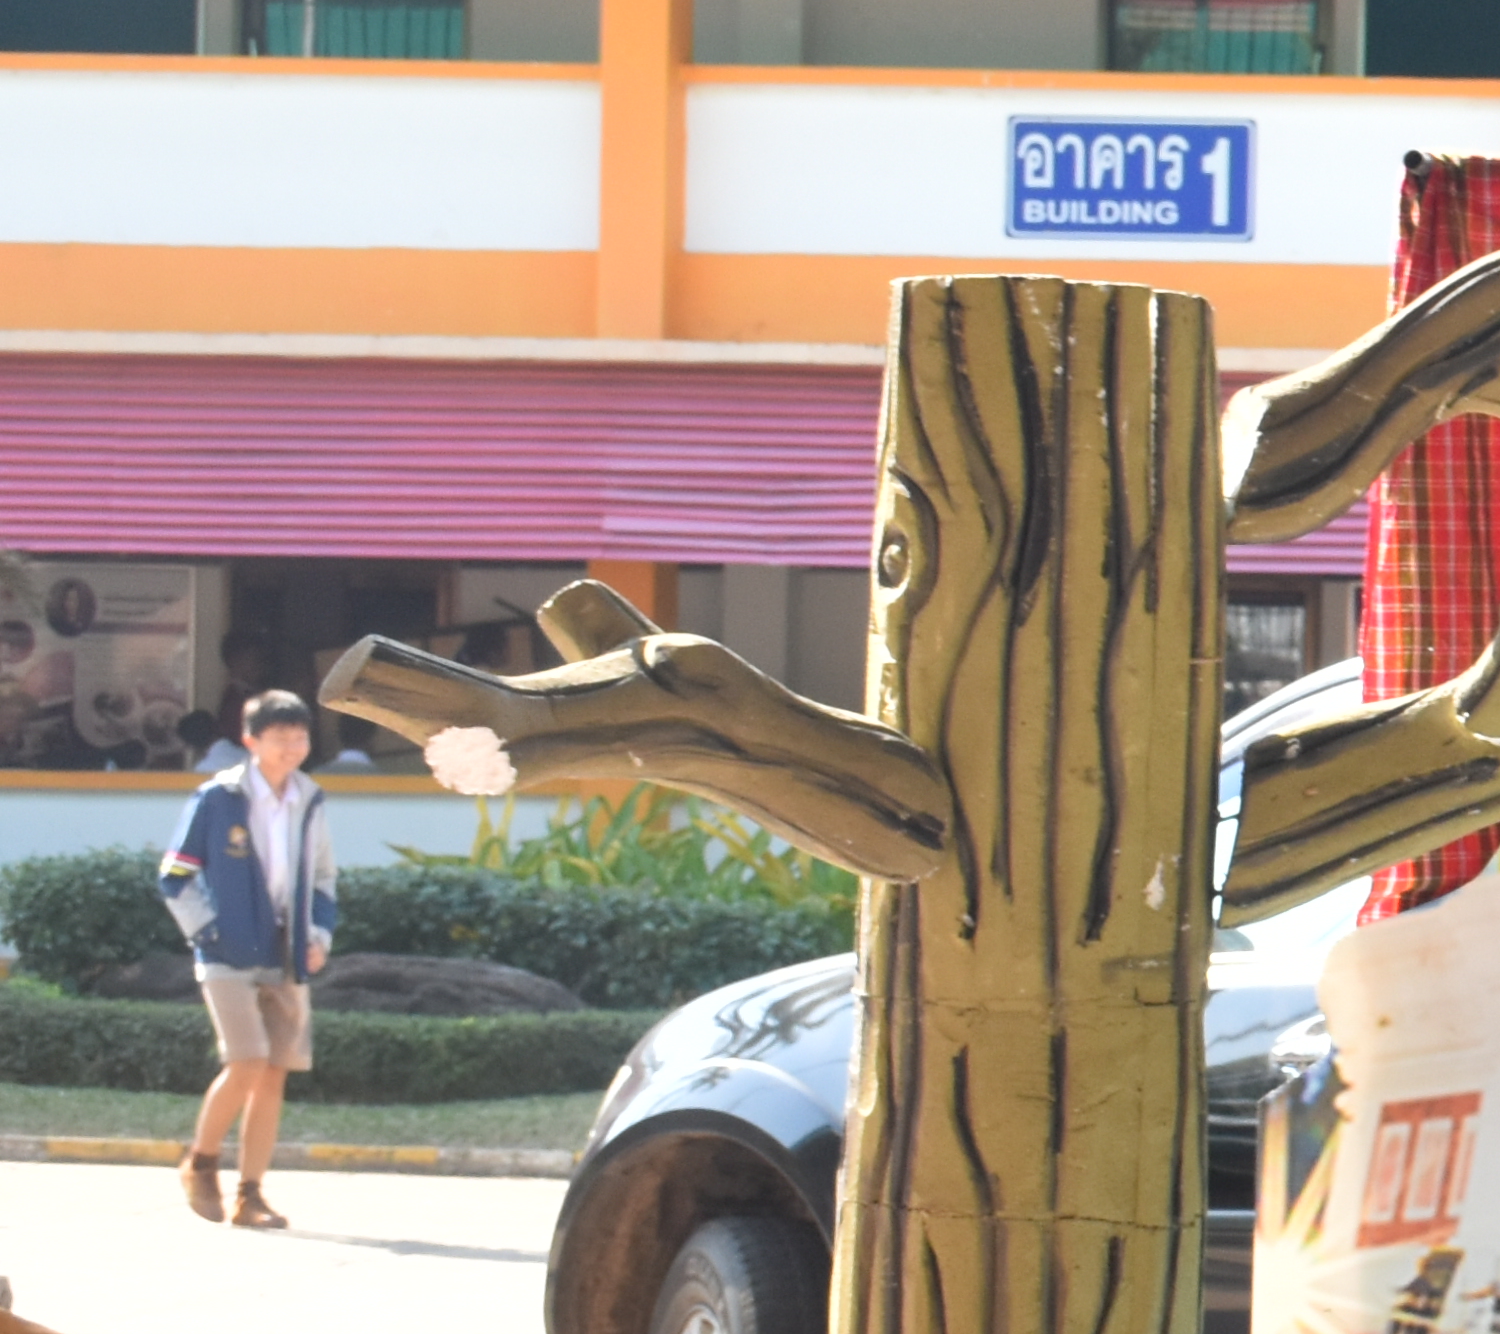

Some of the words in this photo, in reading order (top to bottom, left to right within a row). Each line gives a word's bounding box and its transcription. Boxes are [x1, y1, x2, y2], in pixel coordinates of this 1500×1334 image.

[1017, 132, 1190, 190] อาคาร
[1202, 137, 1230, 226] 1
[1022, 199, 1180, 225] BUILDING
